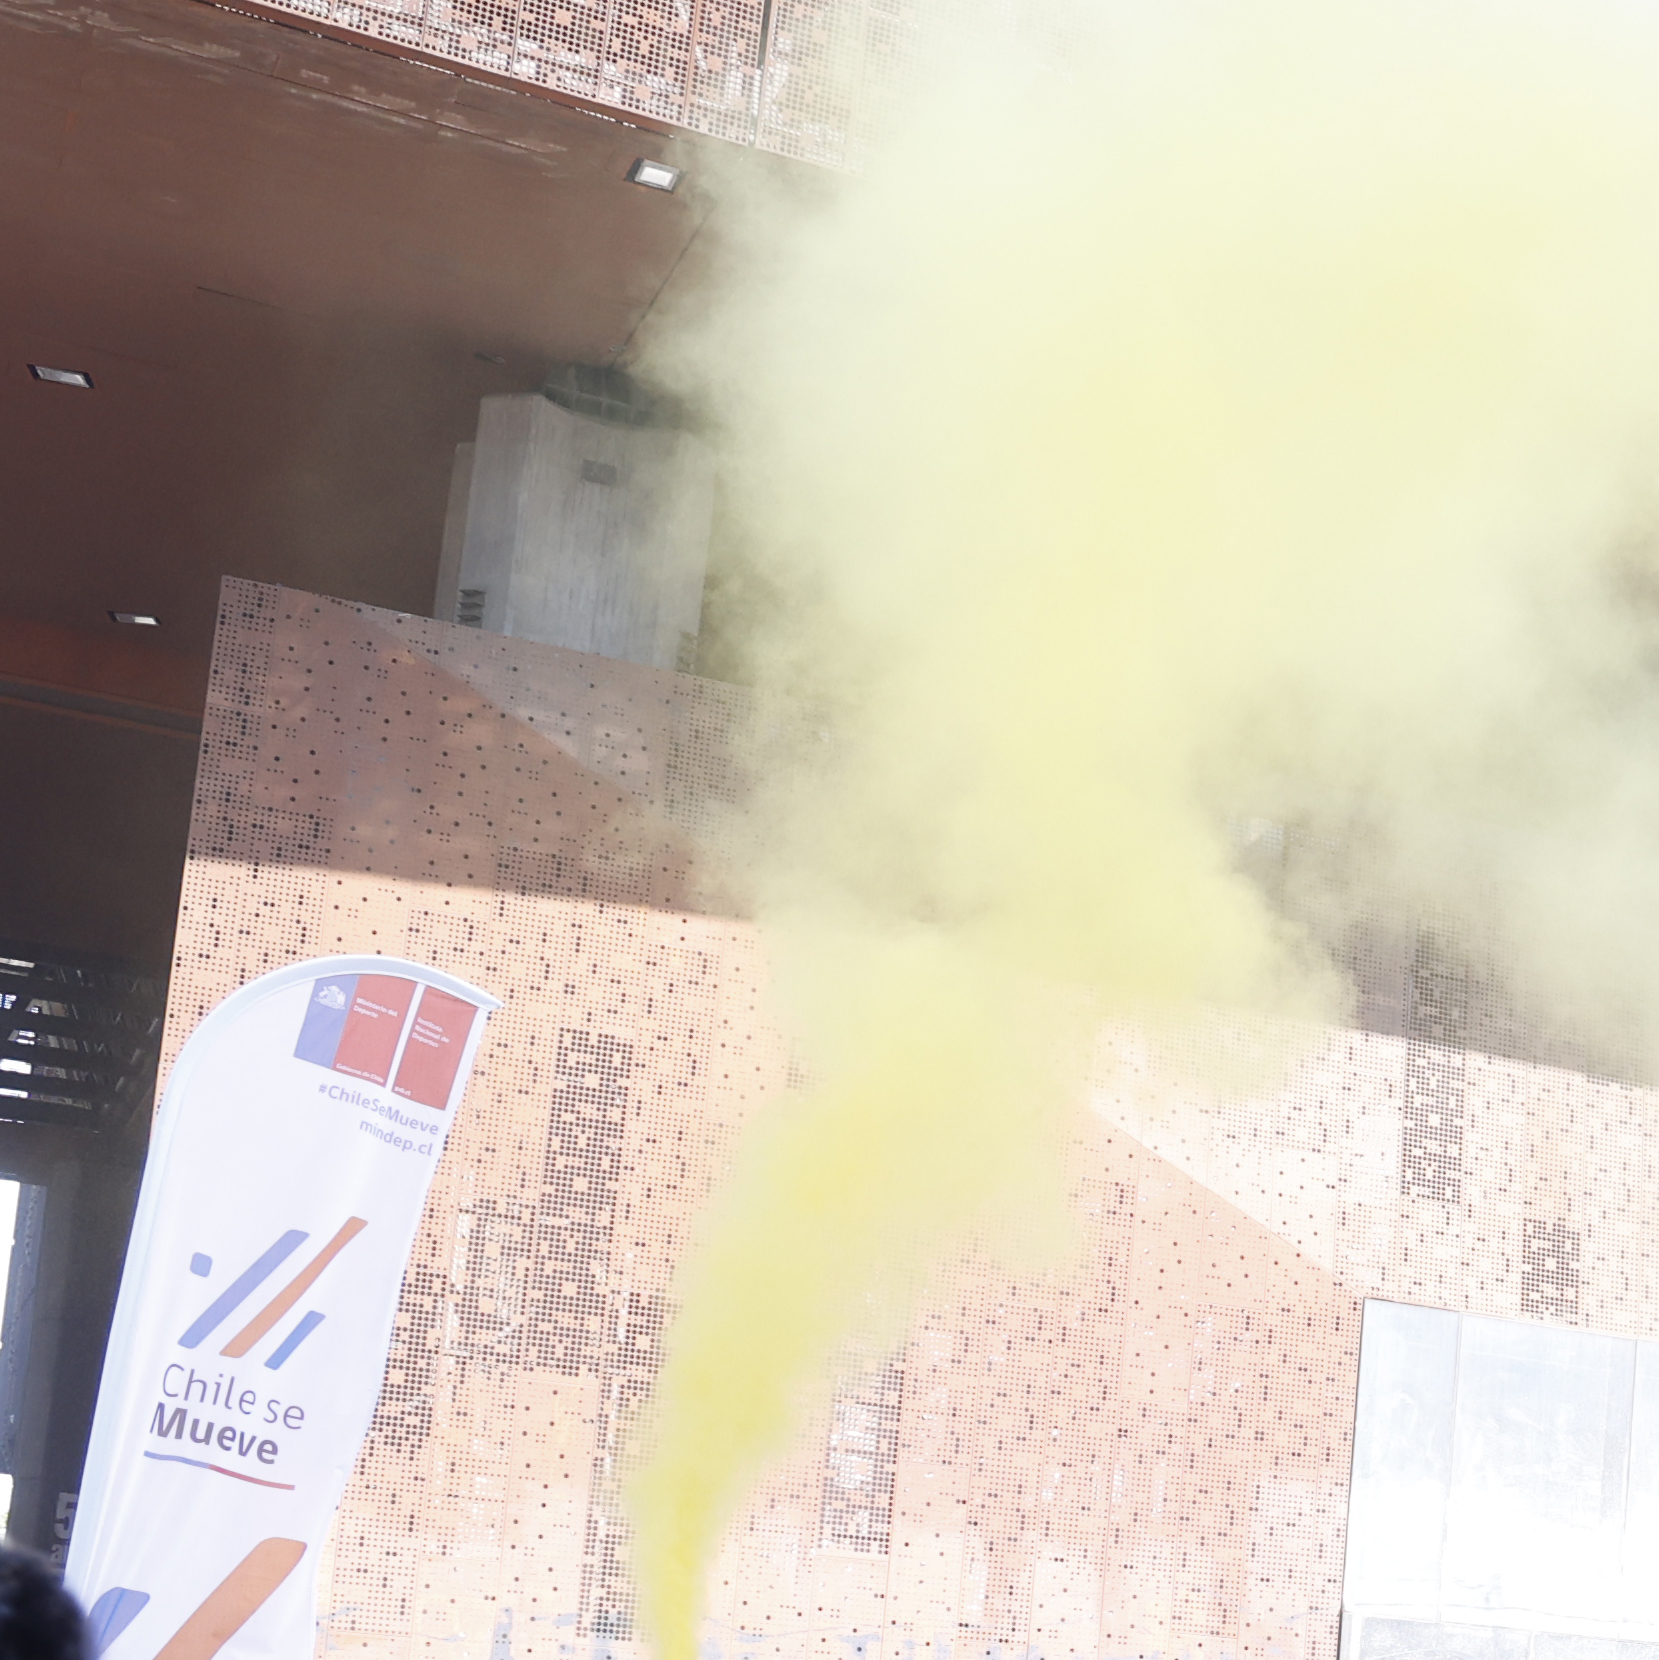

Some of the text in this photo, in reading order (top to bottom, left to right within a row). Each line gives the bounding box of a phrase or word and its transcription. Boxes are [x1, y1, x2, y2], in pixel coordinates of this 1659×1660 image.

[318, 1083, 439, 1136] #ChileSeMueve
[360, 1119, 433, 1156] mindep.cl
[163, 1363, 305, 1430] Chile se
[150, 1401, 279, 1464] Mueve
